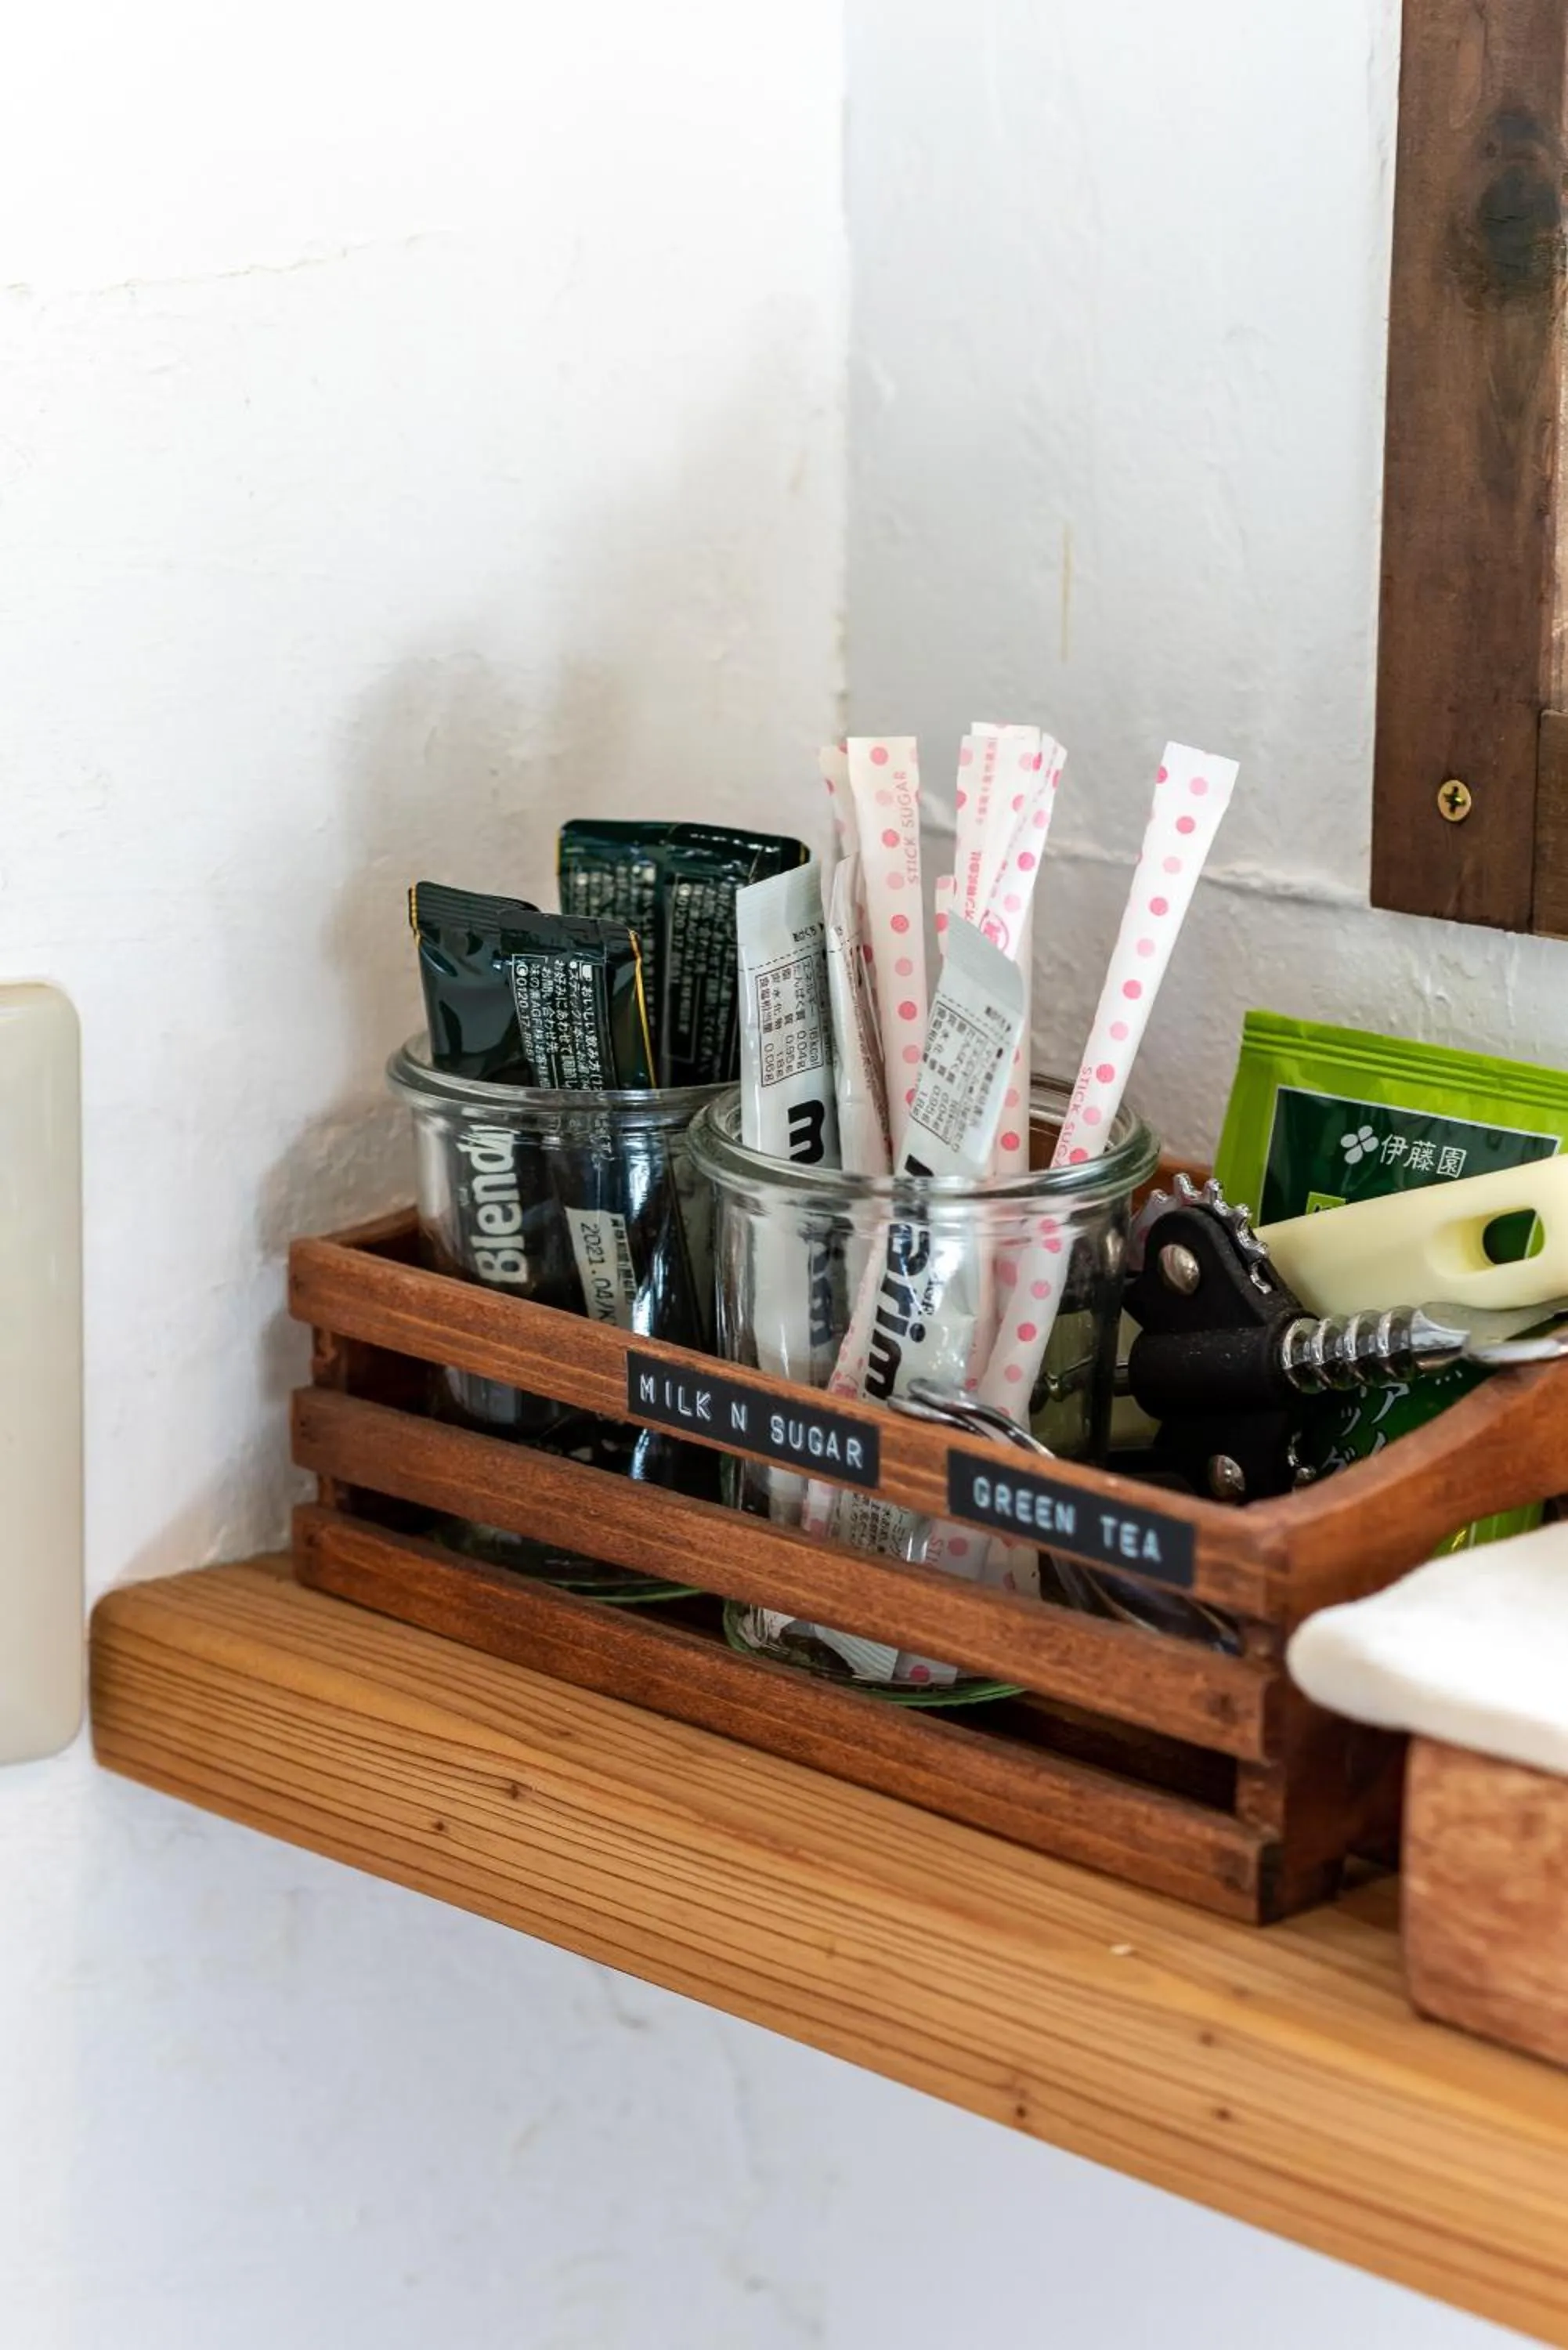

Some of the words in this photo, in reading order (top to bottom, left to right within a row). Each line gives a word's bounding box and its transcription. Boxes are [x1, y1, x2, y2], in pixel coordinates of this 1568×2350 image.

[893, 771, 915, 828] SUGAR
[904, 837, 919, 884] STICK
[1071, 1066, 1092, 1112] STICK
[1380, 1133, 1468, 1179] 伊藤園
[457, 1125, 529, 1284] Blend
[580, 1222, 618, 1325] 2021.04/K
[640, 1373, 711, 1421] MILK
[730, 1401, 747, 1432] N
[770, 1415, 863, 1470] SUGAR
[973, 1476, 1076, 1536] GREEN
[1100, 1514, 1163, 1564] TEA
